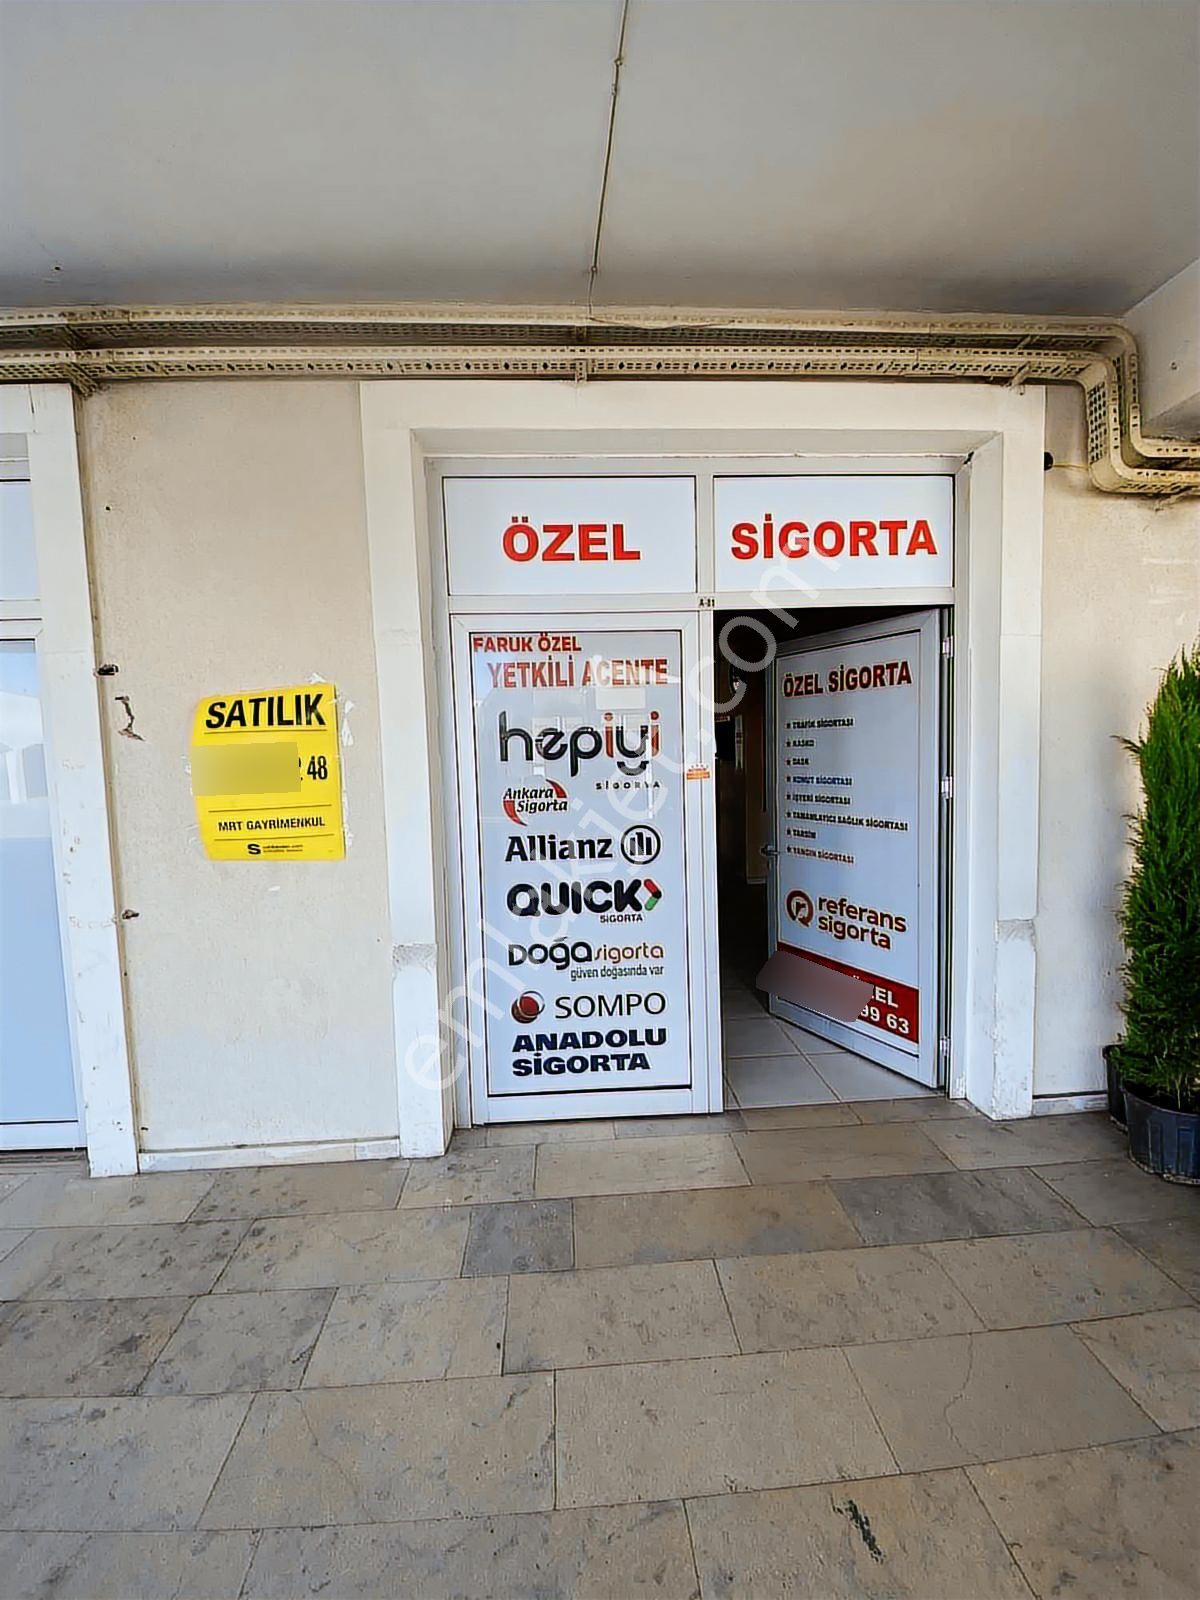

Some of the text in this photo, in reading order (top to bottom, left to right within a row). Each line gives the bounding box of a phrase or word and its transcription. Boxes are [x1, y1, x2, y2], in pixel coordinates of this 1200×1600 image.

[502, 513, 938, 562] ÖZEL SİGORTA
[472, 632, 582, 653] FARUK ÖZEL
[487, 655, 668, 688] YETKİLİ ACENTE
[783, 660, 912, 697] ÖZEL SİGORTA
[205, 693, 326, 729] SATILIK
[816, 717, 854, 728] SİGORTASI
[306, 755, 328, 781] 48
[816, 774, 852, 785] SİGORTASI
[503, 786, 553, 800] Ankara
[516, 800, 568, 814] Sigorta
[218, 816, 325, 832] MRT GAYRİMENKUL
[864, 816, 908, 832] SİGORTASI
[504, 834, 613, 862] Allianz
[506, 878, 642, 917] QUICK
[818, 896, 907, 933] referans
[818, 916, 891, 950] sigorta
[570, 967, 599, 982] güven
[649, 966, 664, 976] var
[555, 992, 666, 1019] SOMPO
[886, 1013, 910, 1035] 63
[512, 1027, 667, 1053] ANADOLU
[512, 1052, 650, 1077] SİGORTA
